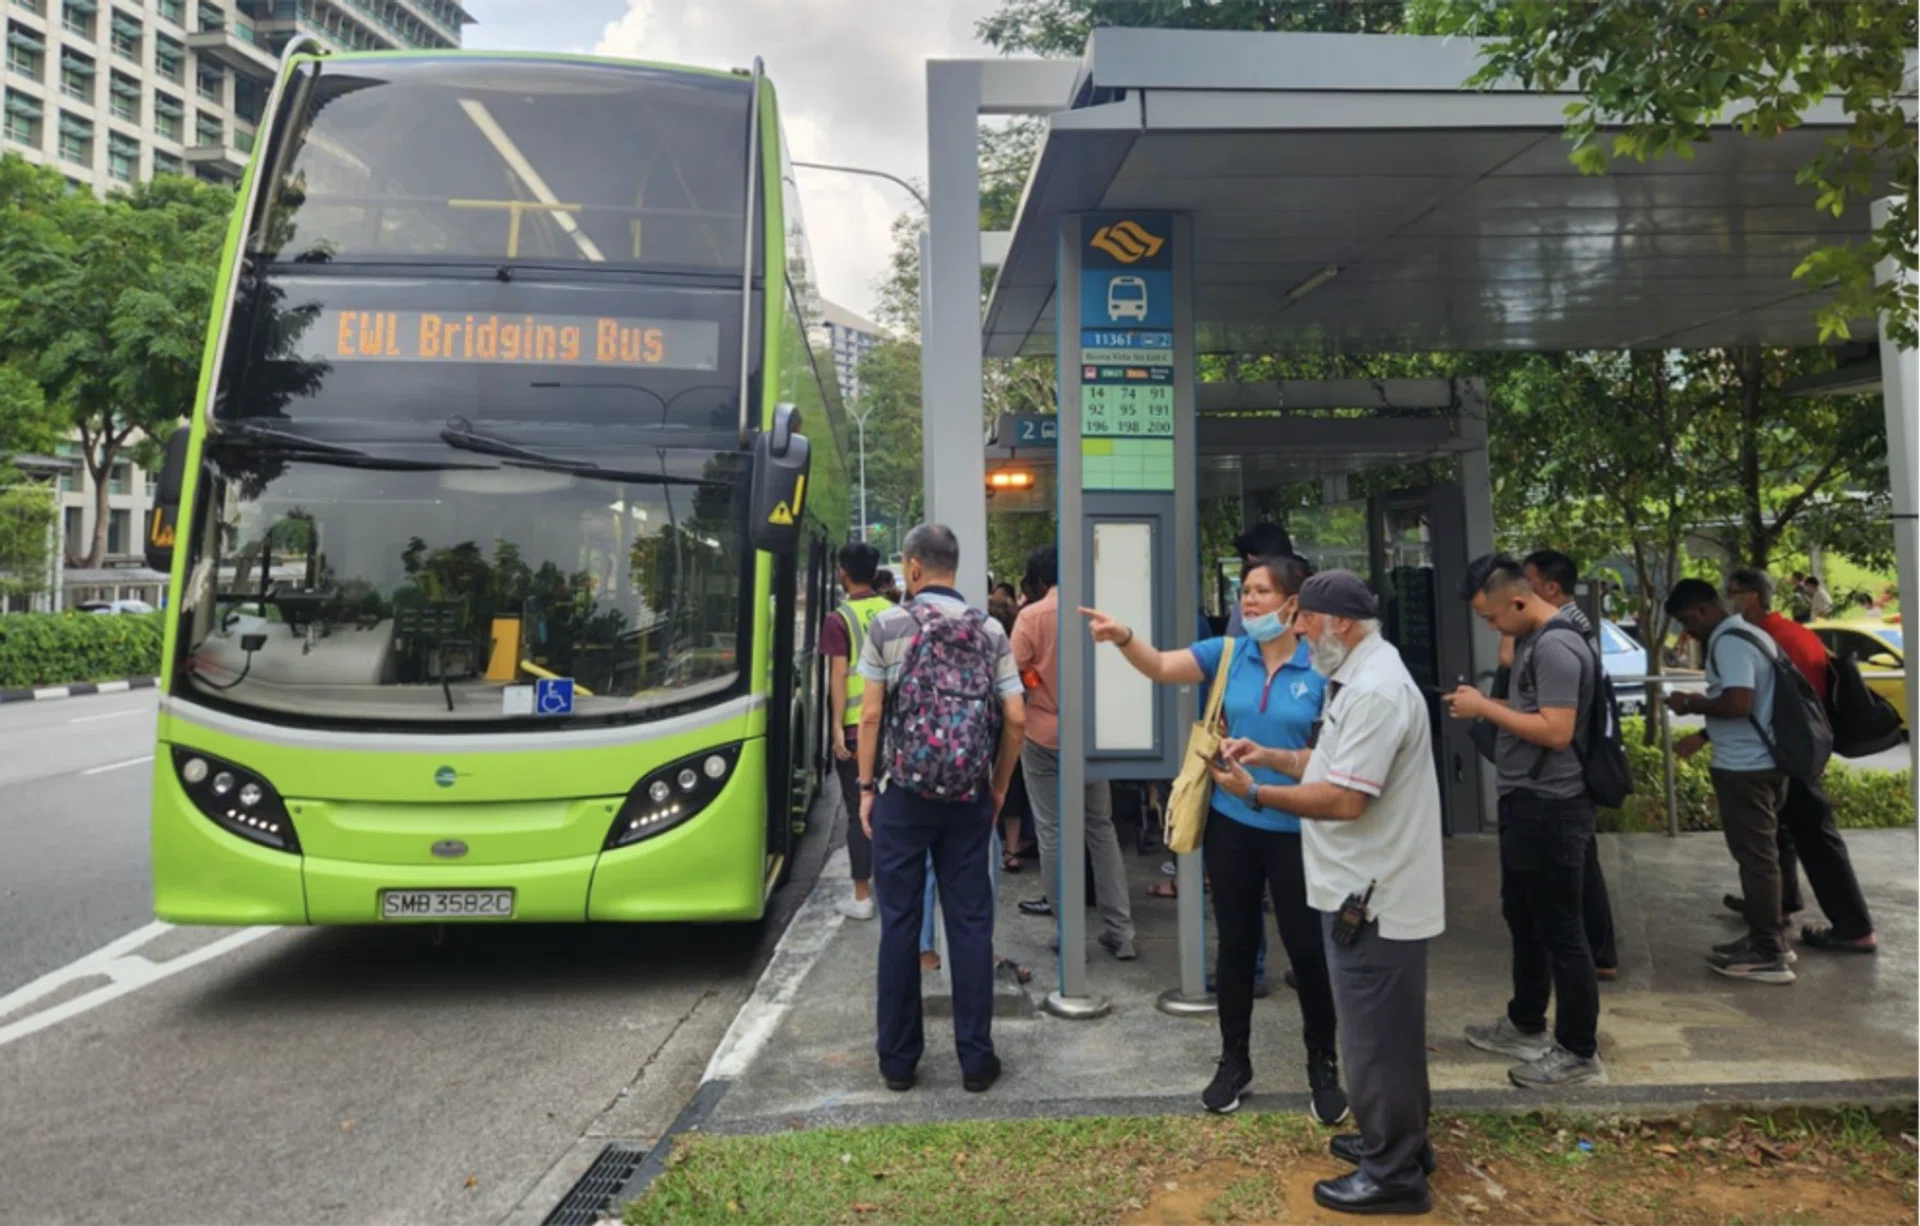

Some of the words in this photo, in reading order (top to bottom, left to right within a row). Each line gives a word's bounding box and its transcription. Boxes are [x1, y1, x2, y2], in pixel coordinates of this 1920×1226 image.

[337, 311, 400, 356] EWL
[419, 312, 580, 361] Bridging
[596, 317, 664, 363] Bus
[1095, 333, 1132, 346] 11361
[1090, 387, 1105, 399] 14
[1121, 387, 1136, 399] 74
[1150, 387, 1165, 399] 91
[1088, 403, 1105, 416] 92
[1119, 403, 1137, 416] 95
[1148, 404, 1169, 416] 191
[1022, 420, 1035, 440] 2
[1086, 420, 1108, 432] 196
[1118, 421, 1140, 433] 198
[1147, 421, 1171, 433] 200
